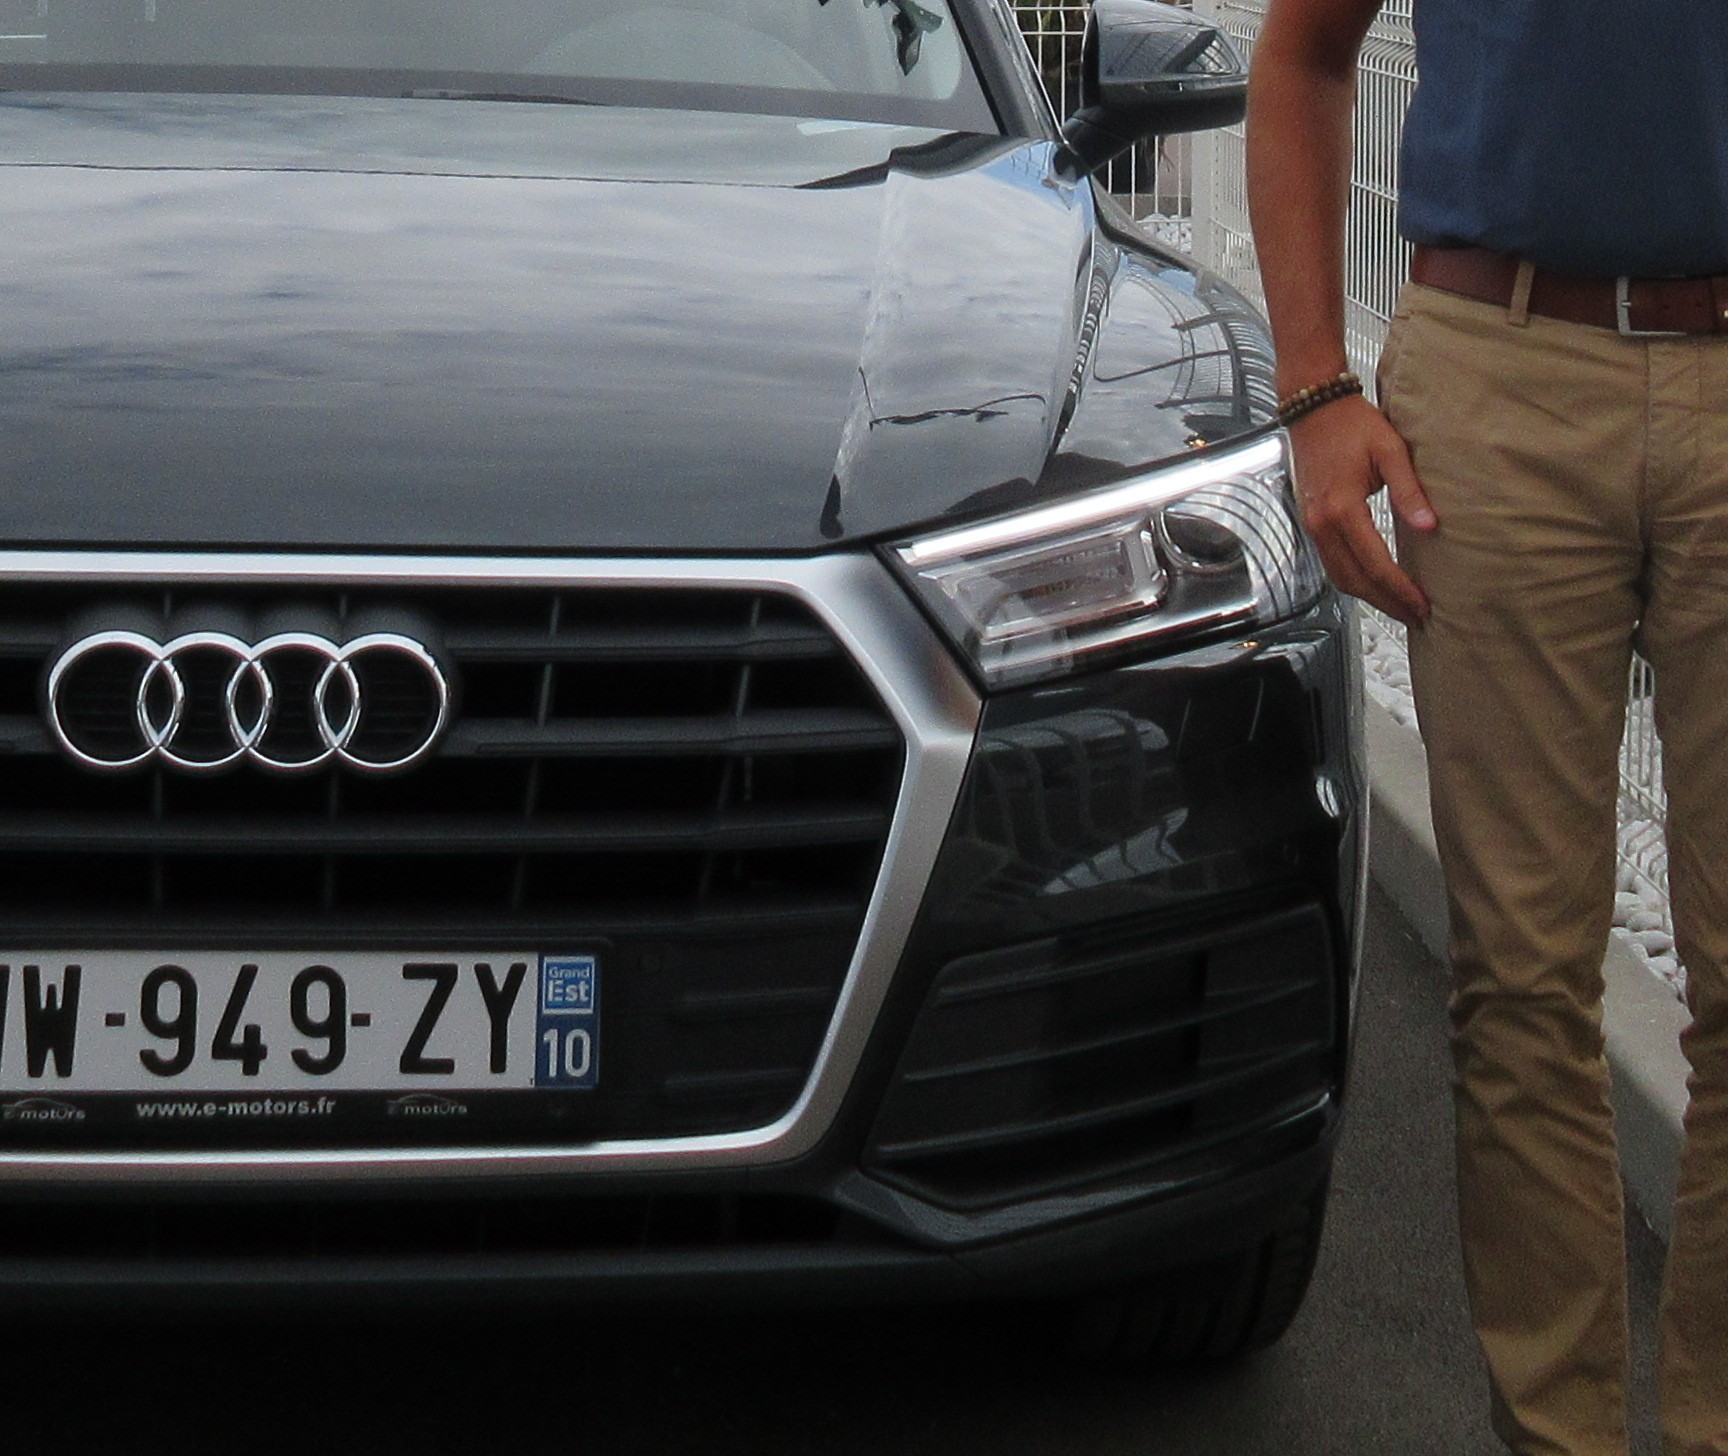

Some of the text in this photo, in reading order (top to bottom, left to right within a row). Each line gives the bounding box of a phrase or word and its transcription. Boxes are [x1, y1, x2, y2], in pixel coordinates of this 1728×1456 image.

[548, 966, 591, 978] Grand
[547, 979, 590, 1002] Est
[543, 1028, 591, 1078] 10
[135, 1097, 336, 1118] www.e-motors.fr
